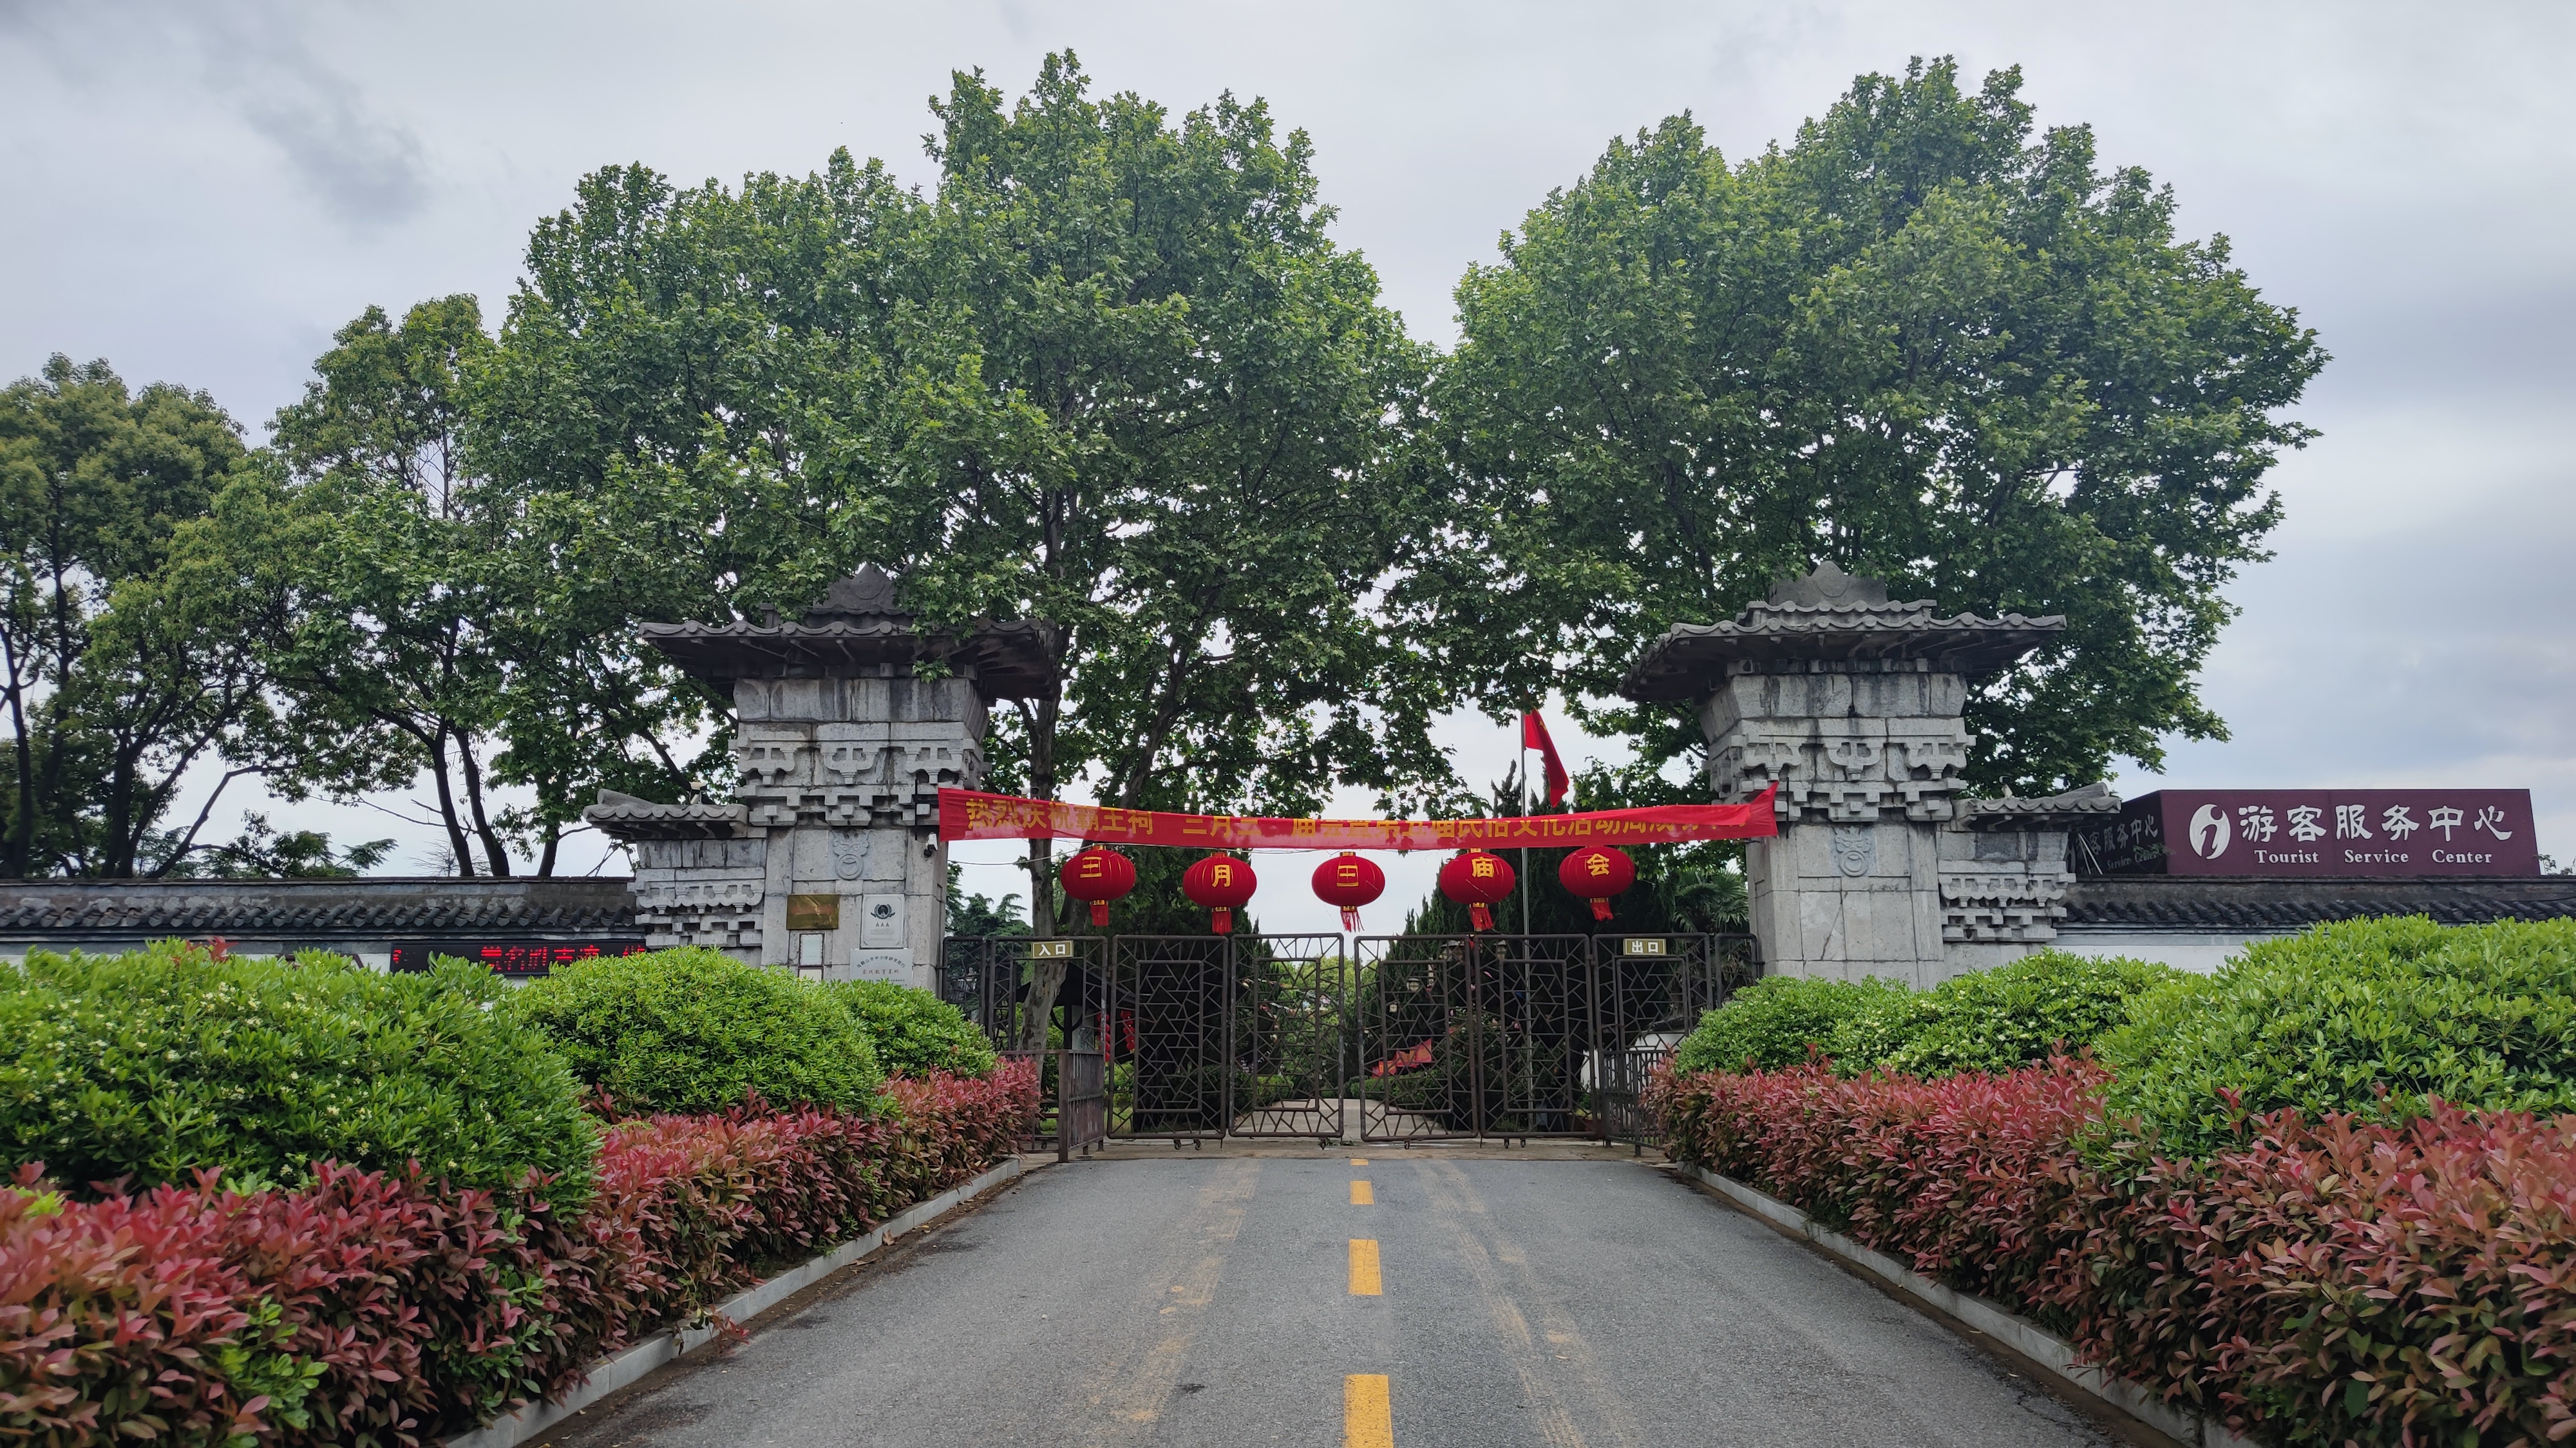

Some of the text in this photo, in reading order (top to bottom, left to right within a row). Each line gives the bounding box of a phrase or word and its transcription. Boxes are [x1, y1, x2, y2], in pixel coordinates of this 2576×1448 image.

[2076, 814, 2158, 857] 客服务中心
[2237, 804, 2513, 843] 游客服务中心
[2254, 848, 2492, 864] Tourist Service Center
[1212, 864, 1231, 887] 月
[1472, 857, 1494, 878] 庙
[1587, 853, 1610, 877] 会
[1038, 944, 1066, 957] 入口
[1631, 940, 1659, 953] 出口
